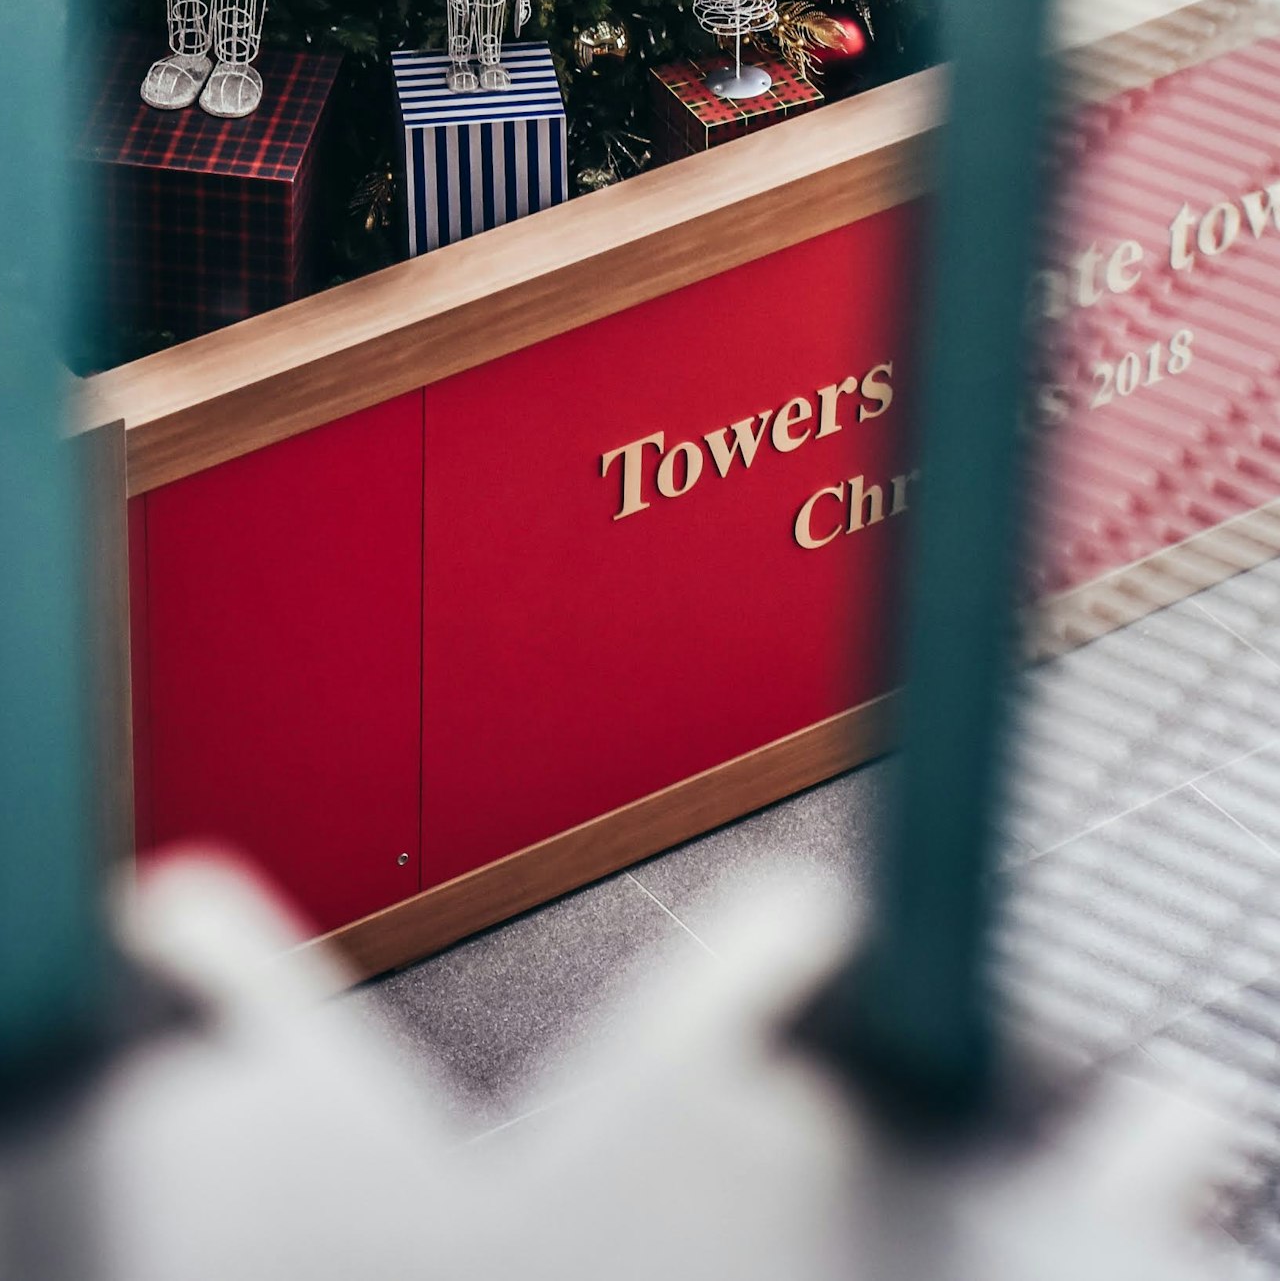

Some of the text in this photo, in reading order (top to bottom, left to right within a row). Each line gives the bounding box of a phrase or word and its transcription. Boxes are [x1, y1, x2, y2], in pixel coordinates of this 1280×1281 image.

[600, 360, 893, 521] Towers
[1026, 239, 1144, 318] ate
[1090, 328, 1195, 410] 2018
